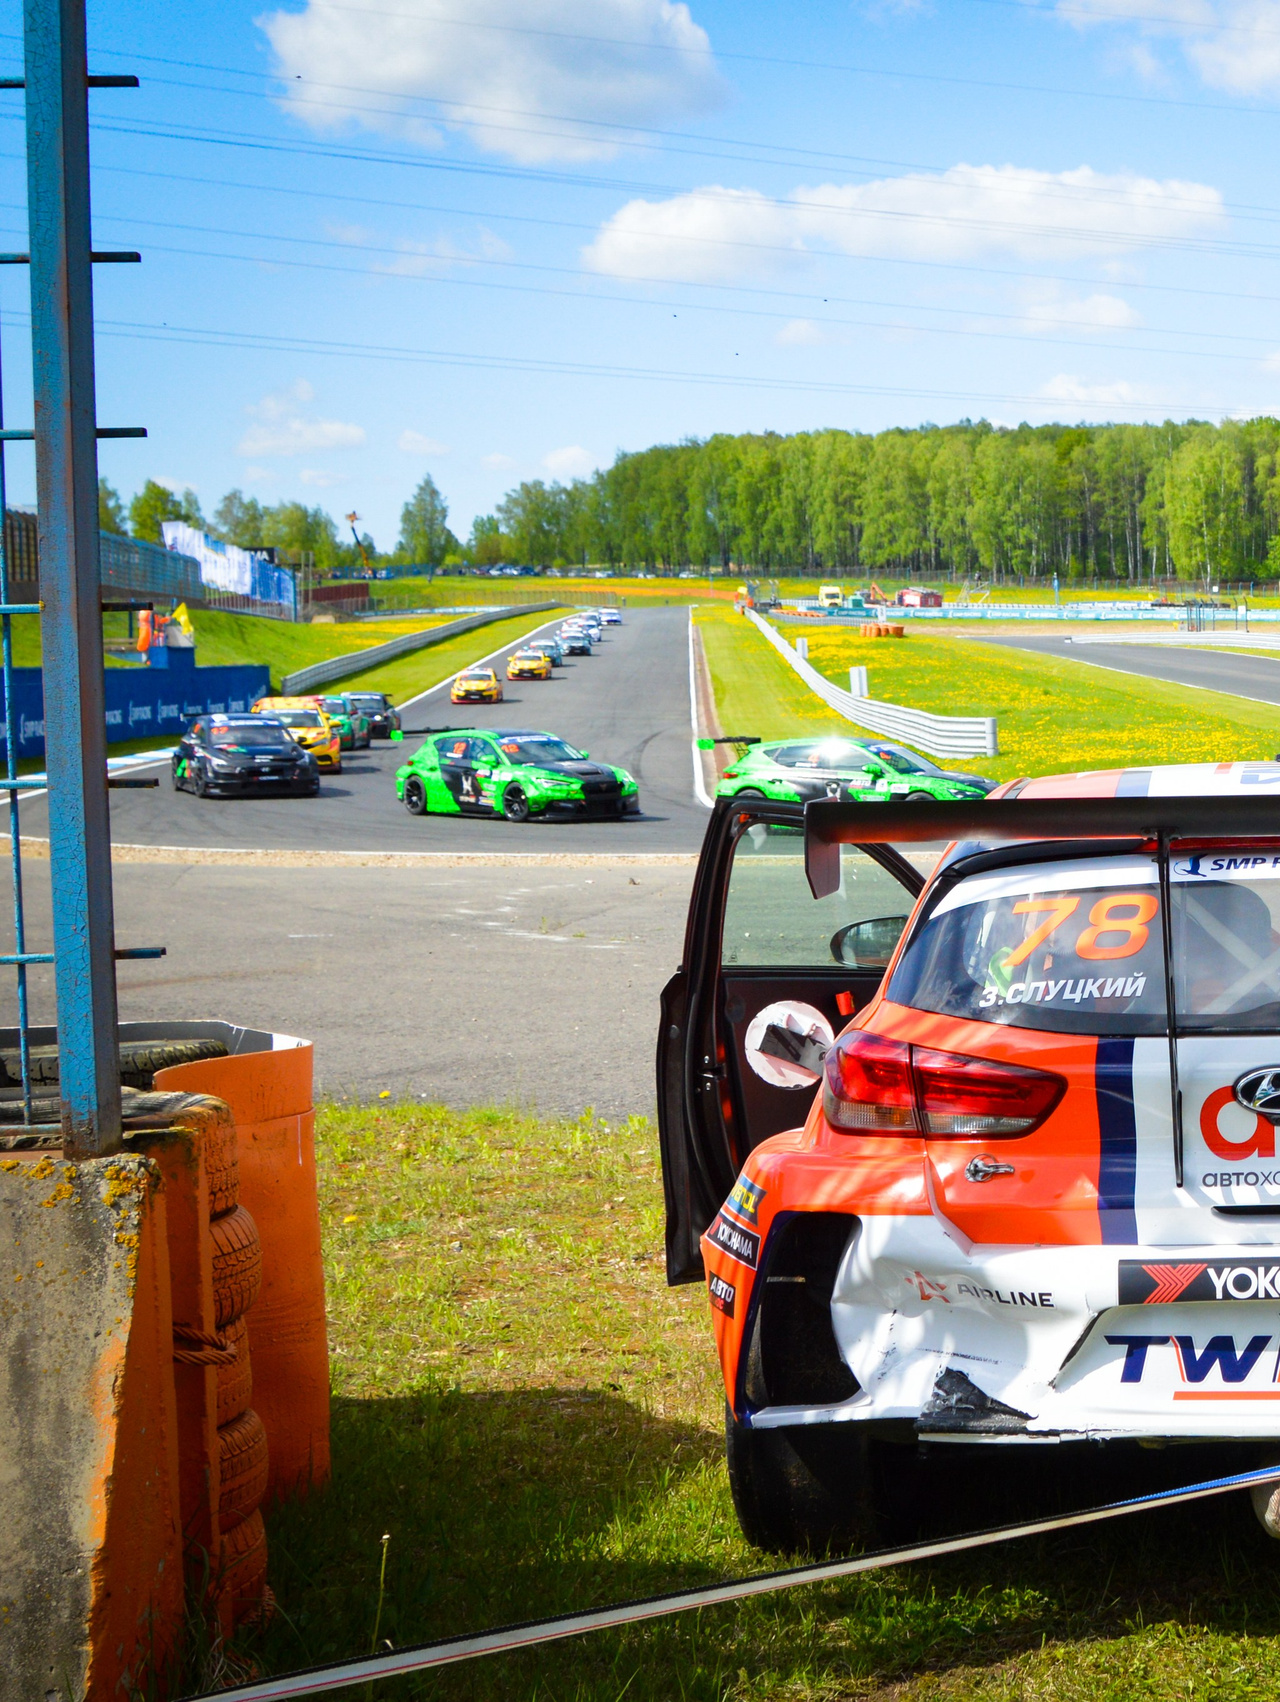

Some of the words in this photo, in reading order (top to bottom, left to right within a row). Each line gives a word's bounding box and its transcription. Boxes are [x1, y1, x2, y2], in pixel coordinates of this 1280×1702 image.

[1210, 856, 1267, 872] SMP
[1002, 892, 1159, 967] 78
[979, 972, 1147, 1008] З.СЛУЦКИЙ
[717, 1221, 752, 1258] YOKOHAMA
[709, 1276, 735, 1302] АВТО
[956, 1281, 1055, 1308] AIRLINE
